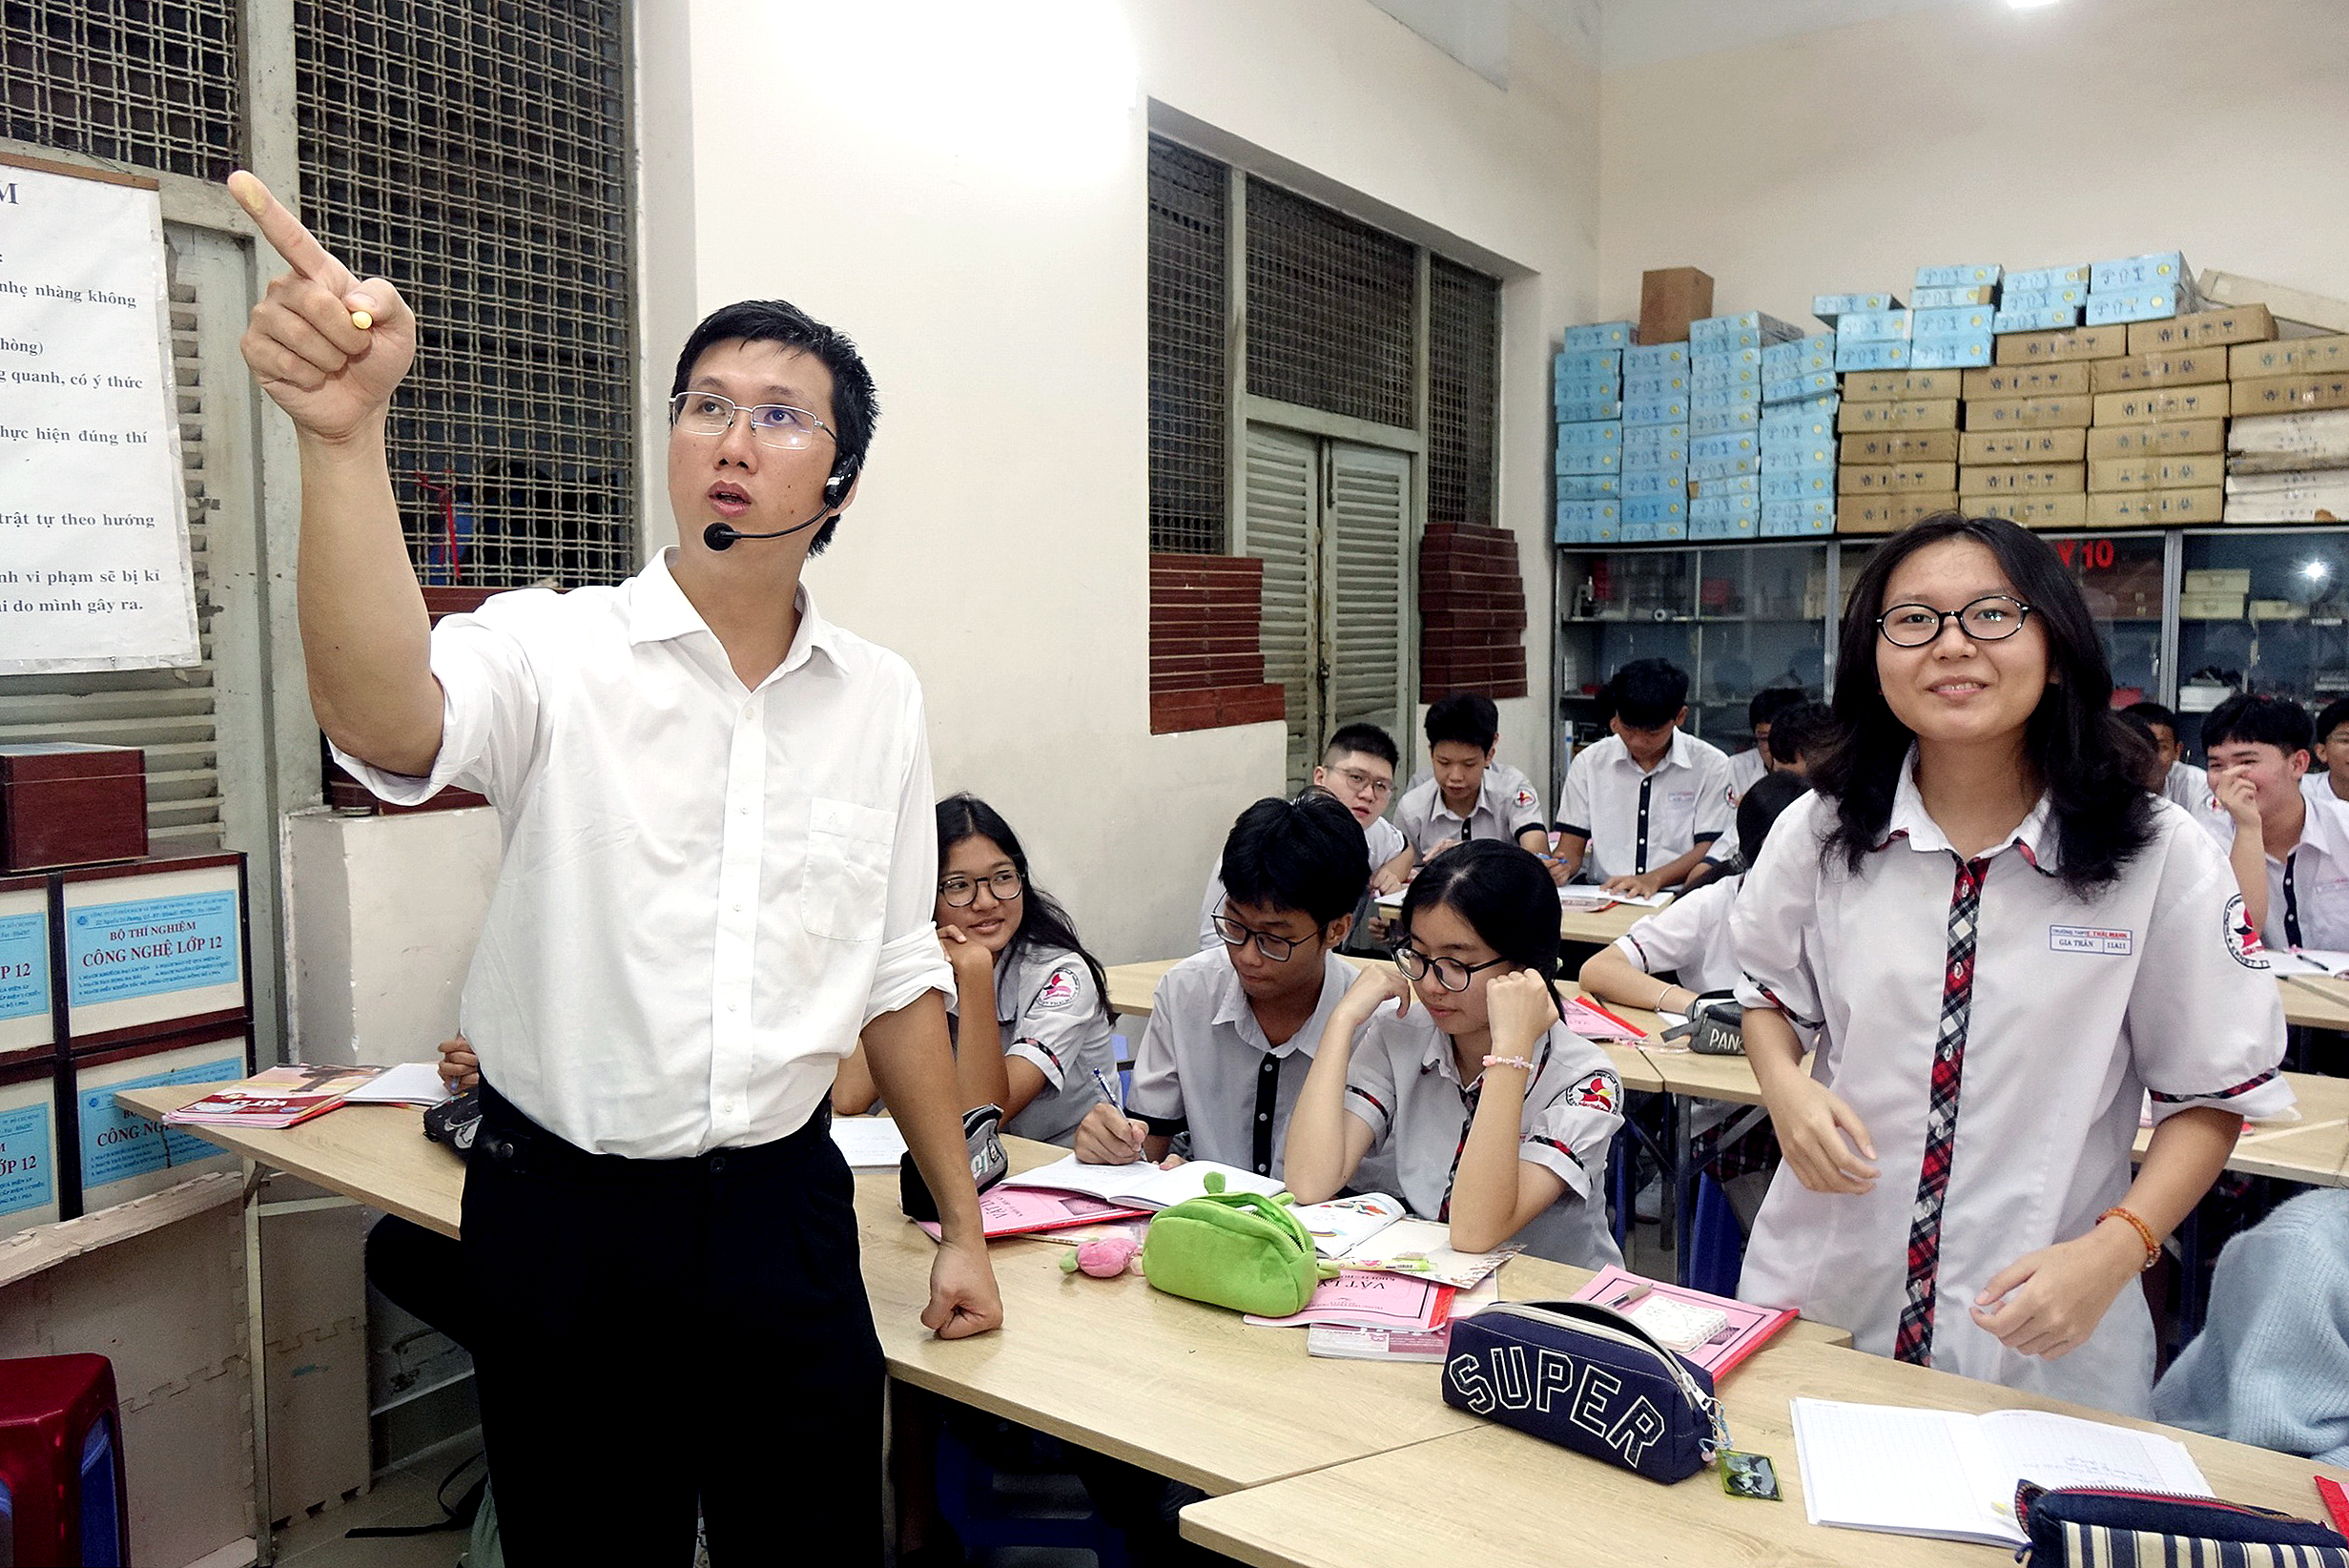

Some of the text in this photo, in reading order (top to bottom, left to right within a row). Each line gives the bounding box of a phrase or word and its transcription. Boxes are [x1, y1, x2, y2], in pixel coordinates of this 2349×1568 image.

[35, 284, 82, 303] nhàng
[88, 289, 137, 309] không
[11, 371, 66, 384] quanh,
[70, 373, 88, 386] có
[93, 374, 102, 389] ý
[108, 375, 143, 389] thức
[36, 427, 71, 444] hiện
[78, 429, 119, 446] đúng
[125, 431, 148, 444] thí
[36, 513, 55, 528] tự
[61, 513, 96, 526] theo
[103, 513, 155, 528] hướng
[2082, 539, 2114, 570] 10
[27, 570, 41, 583] vi
[48, 570, 93, 586] phạm
[99, 570, 116, 583] sẽ
[122, 569, 138, 585] bị
[13, 600, 33, 612] do
[39, 599, 82, 612] mình
[88, 598, 115, 614] gây
[121, 601, 144, 610] ra.
[110, 930, 126, 941] BỘ
[151, 920, 196, 936] NGHIỆM
[82, 935, 223, 967] CÔNG NGHỆ LỚP 12
[15, 962, 31, 979] 12
[97, 1124, 140, 1147] CÔNG
[21, 1154, 37, 1170] 12
[1449, 1346, 1665, 1469] SUPER
